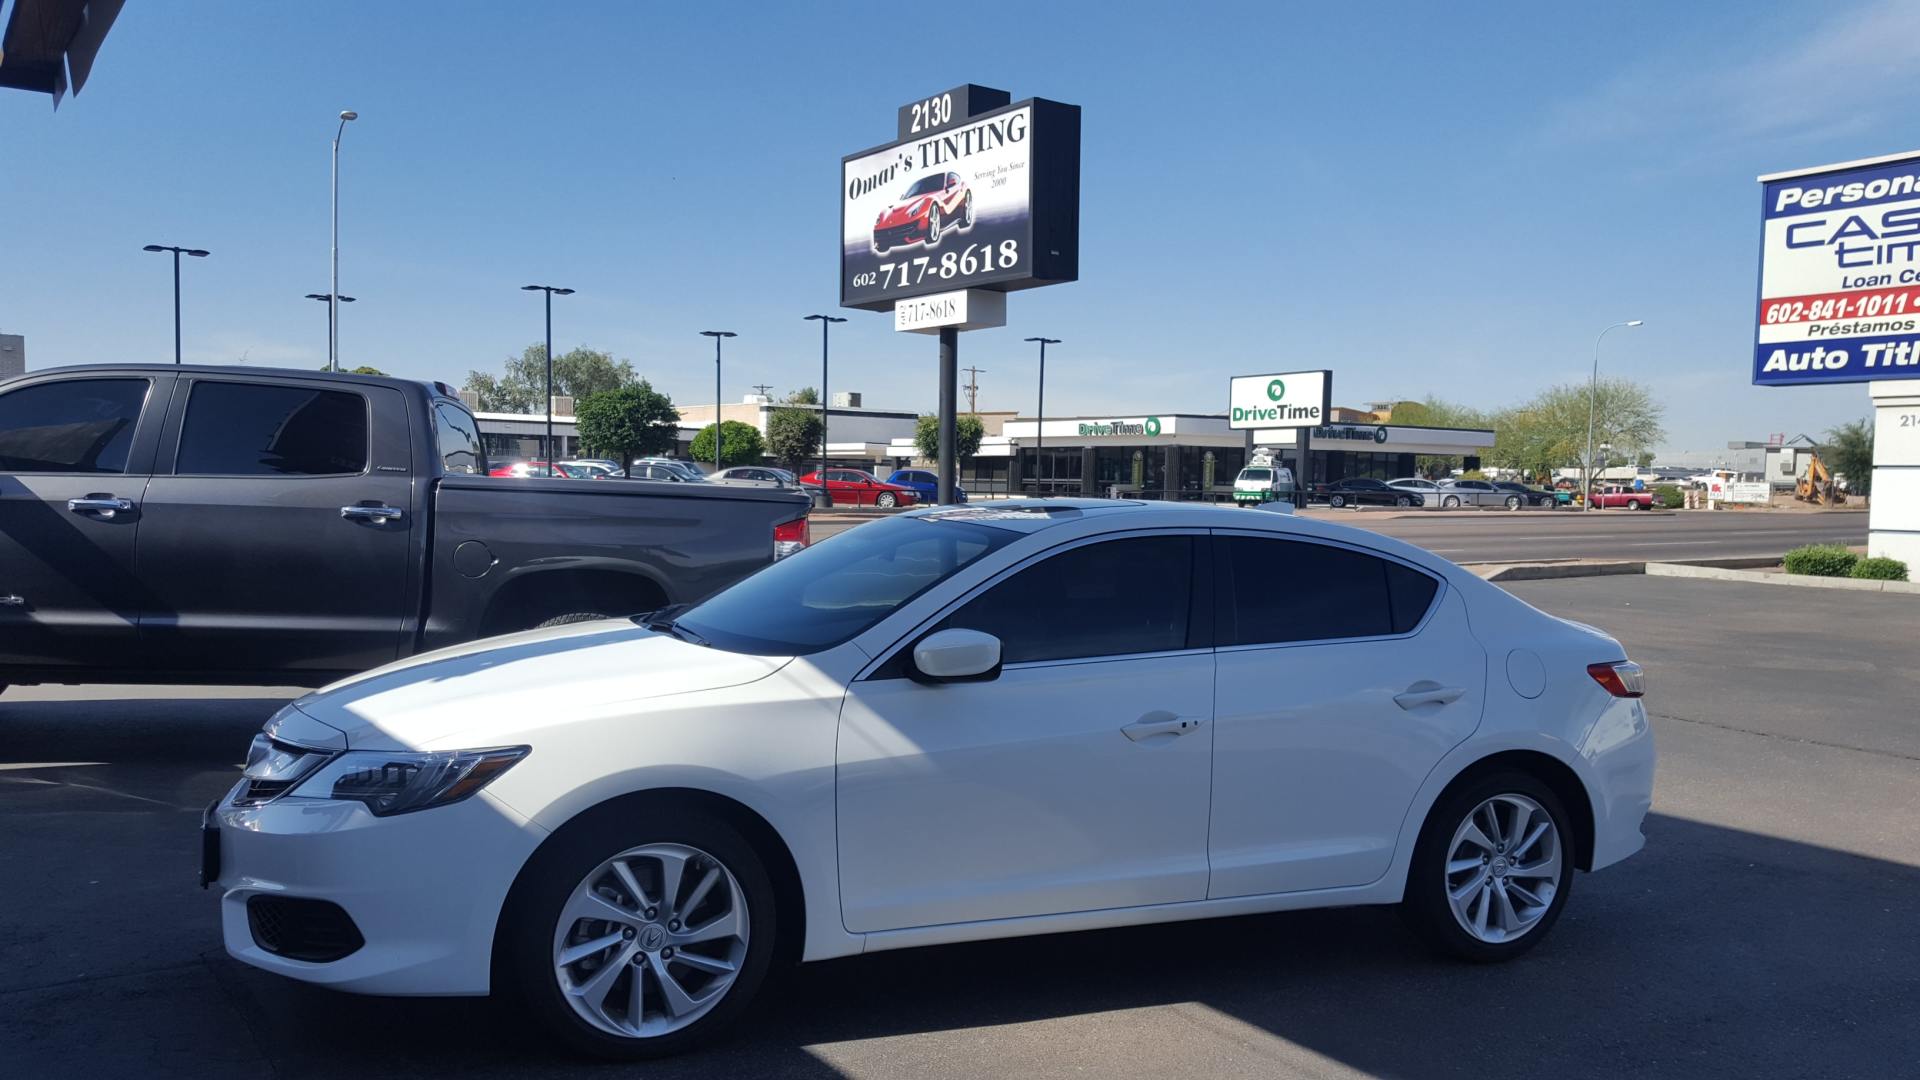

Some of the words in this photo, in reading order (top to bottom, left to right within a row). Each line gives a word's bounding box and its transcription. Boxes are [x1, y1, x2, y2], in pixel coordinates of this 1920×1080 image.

[911, 93, 952, 133] 2130
[849, 152, 913, 200] Omar's
[918, 113, 1027, 169] TINTING
[1786, 207, 1920, 249] CAS
[853, 272, 876, 288] 602
[880, 239, 1018, 290] 717-8618
[1842, 274, 1892, 289] Loan
[908, 298, 956, 323] 717-8618
[1766, 292, 1909, 325] 602-841-1011
[1807, 319, 1915, 337] Préstamos
[1763, 347, 1849, 373] Auto
[1861, 341, 1920, 367] Titl
[1079, 421, 1144, 436] DriveTime
[1232, 403, 1320, 422] DriveTime
